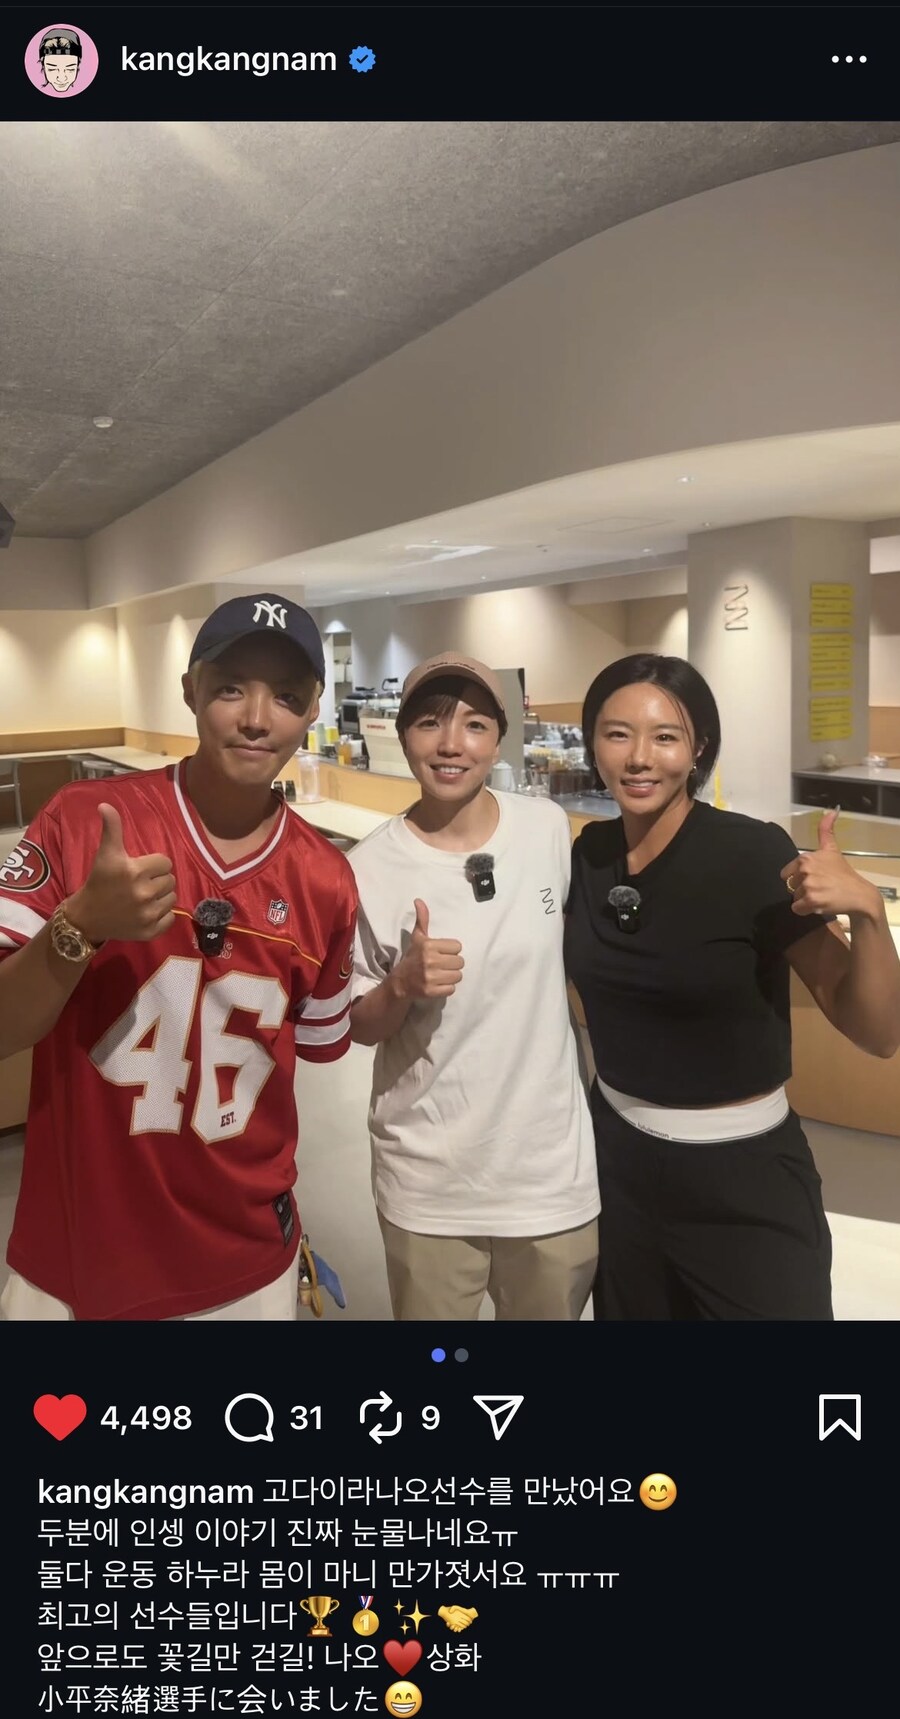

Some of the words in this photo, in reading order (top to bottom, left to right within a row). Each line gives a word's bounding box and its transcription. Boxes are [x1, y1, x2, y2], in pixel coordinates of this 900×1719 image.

[252, 600, 288, 629] NY
[270, 908, 286, 920] NFL
[88, 955, 289, 1145] 46
[220, 1111, 236, 1127] EST.
